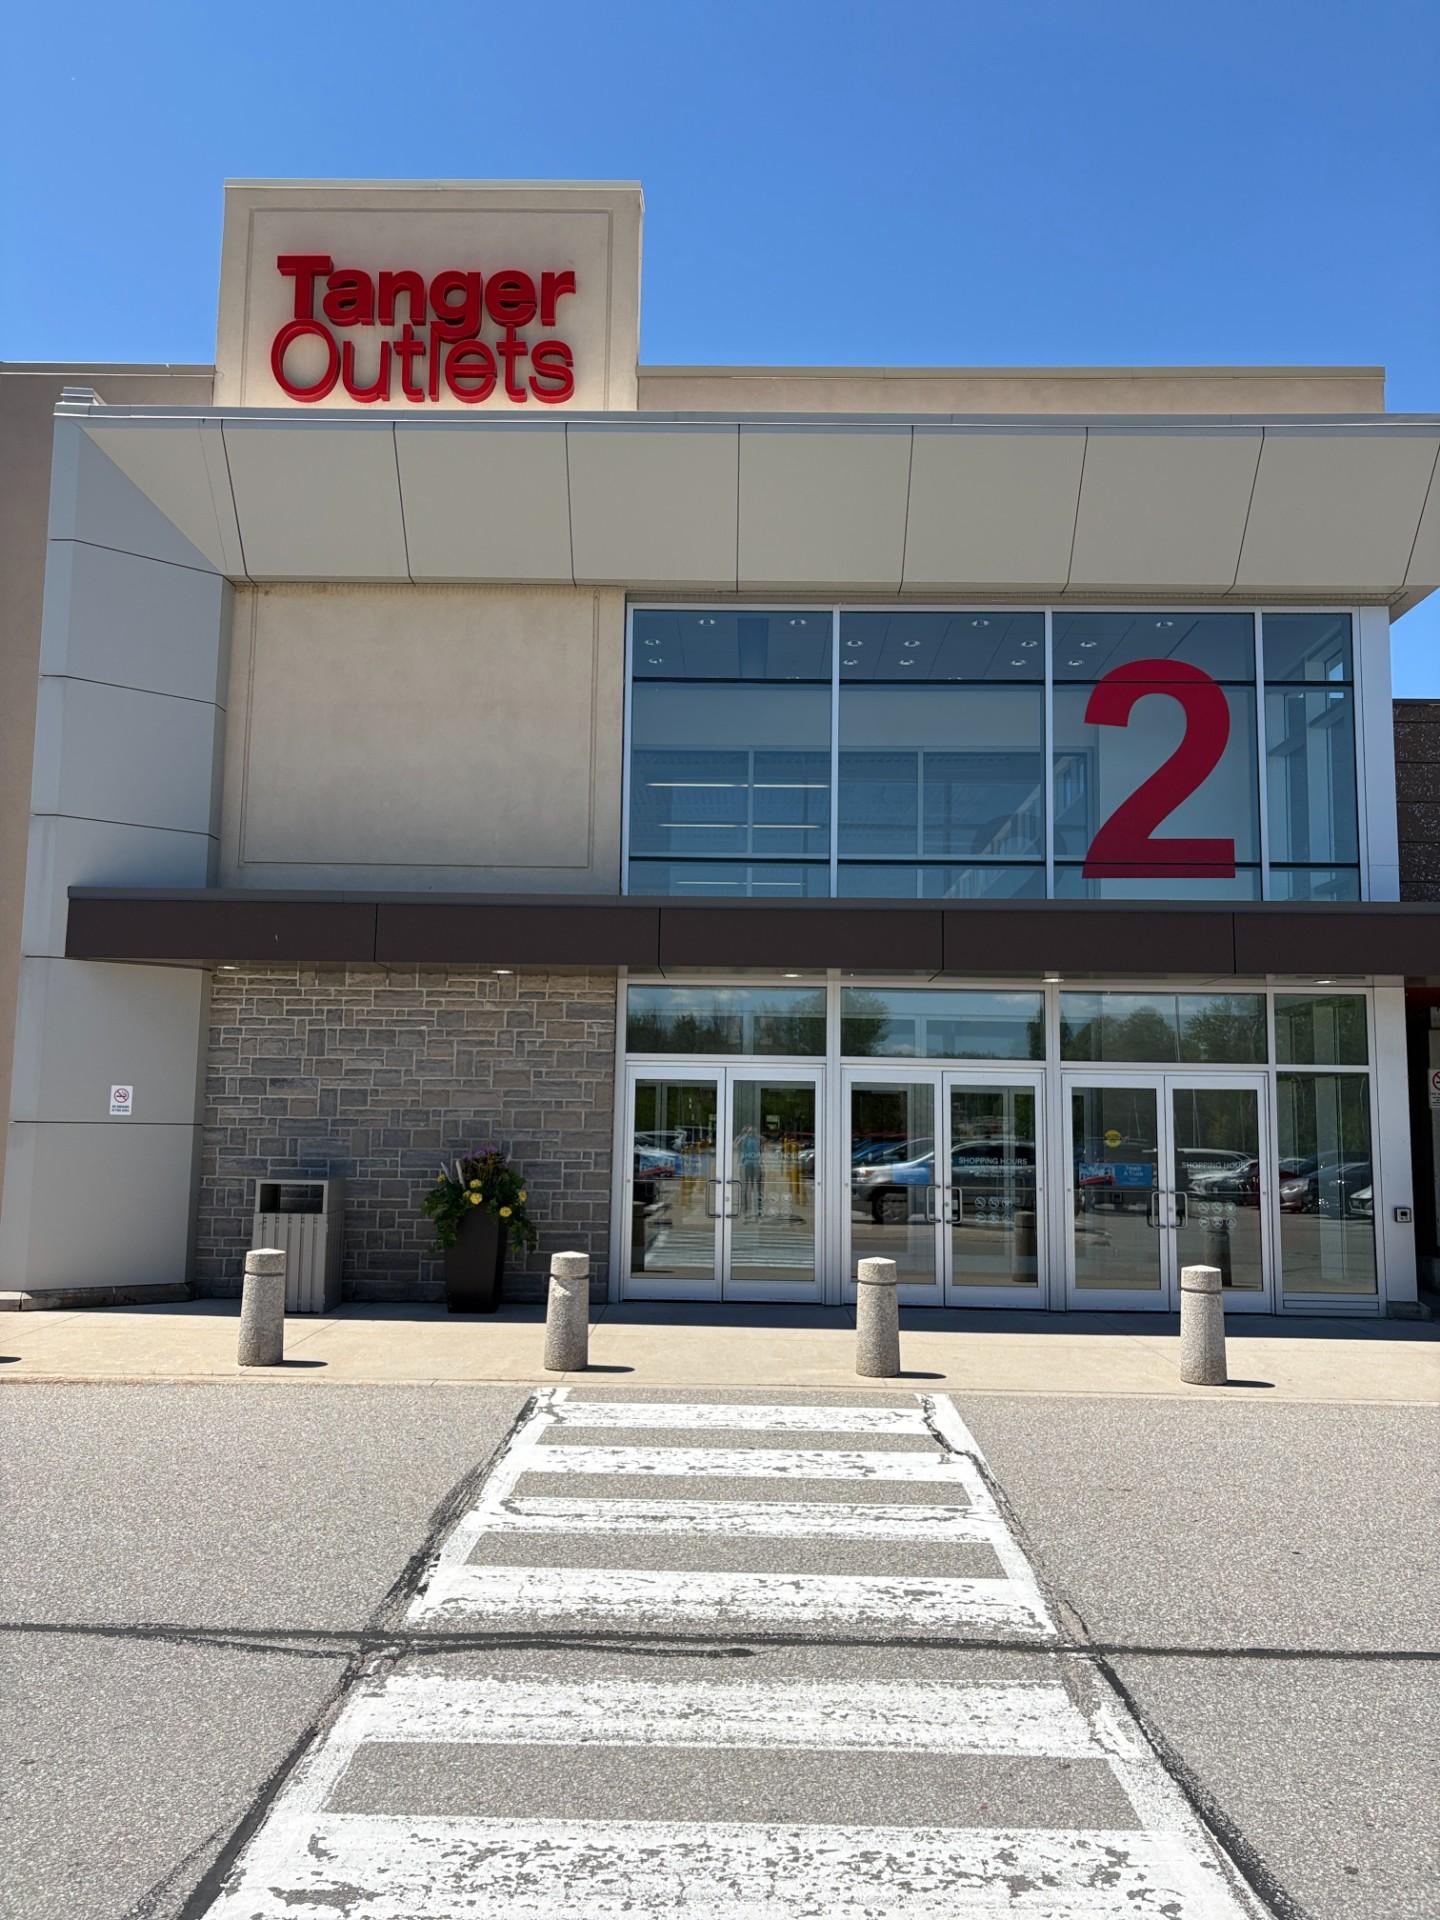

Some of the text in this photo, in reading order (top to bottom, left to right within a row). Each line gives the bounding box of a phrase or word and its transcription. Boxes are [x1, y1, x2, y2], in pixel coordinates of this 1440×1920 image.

[276, 255, 577, 343] Tanger
[270, 319, 576, 404] Outlets
[1082, 658, 1236, 878] 2
[958, 1156, 1028, 1166] SHOPPING HOURS
